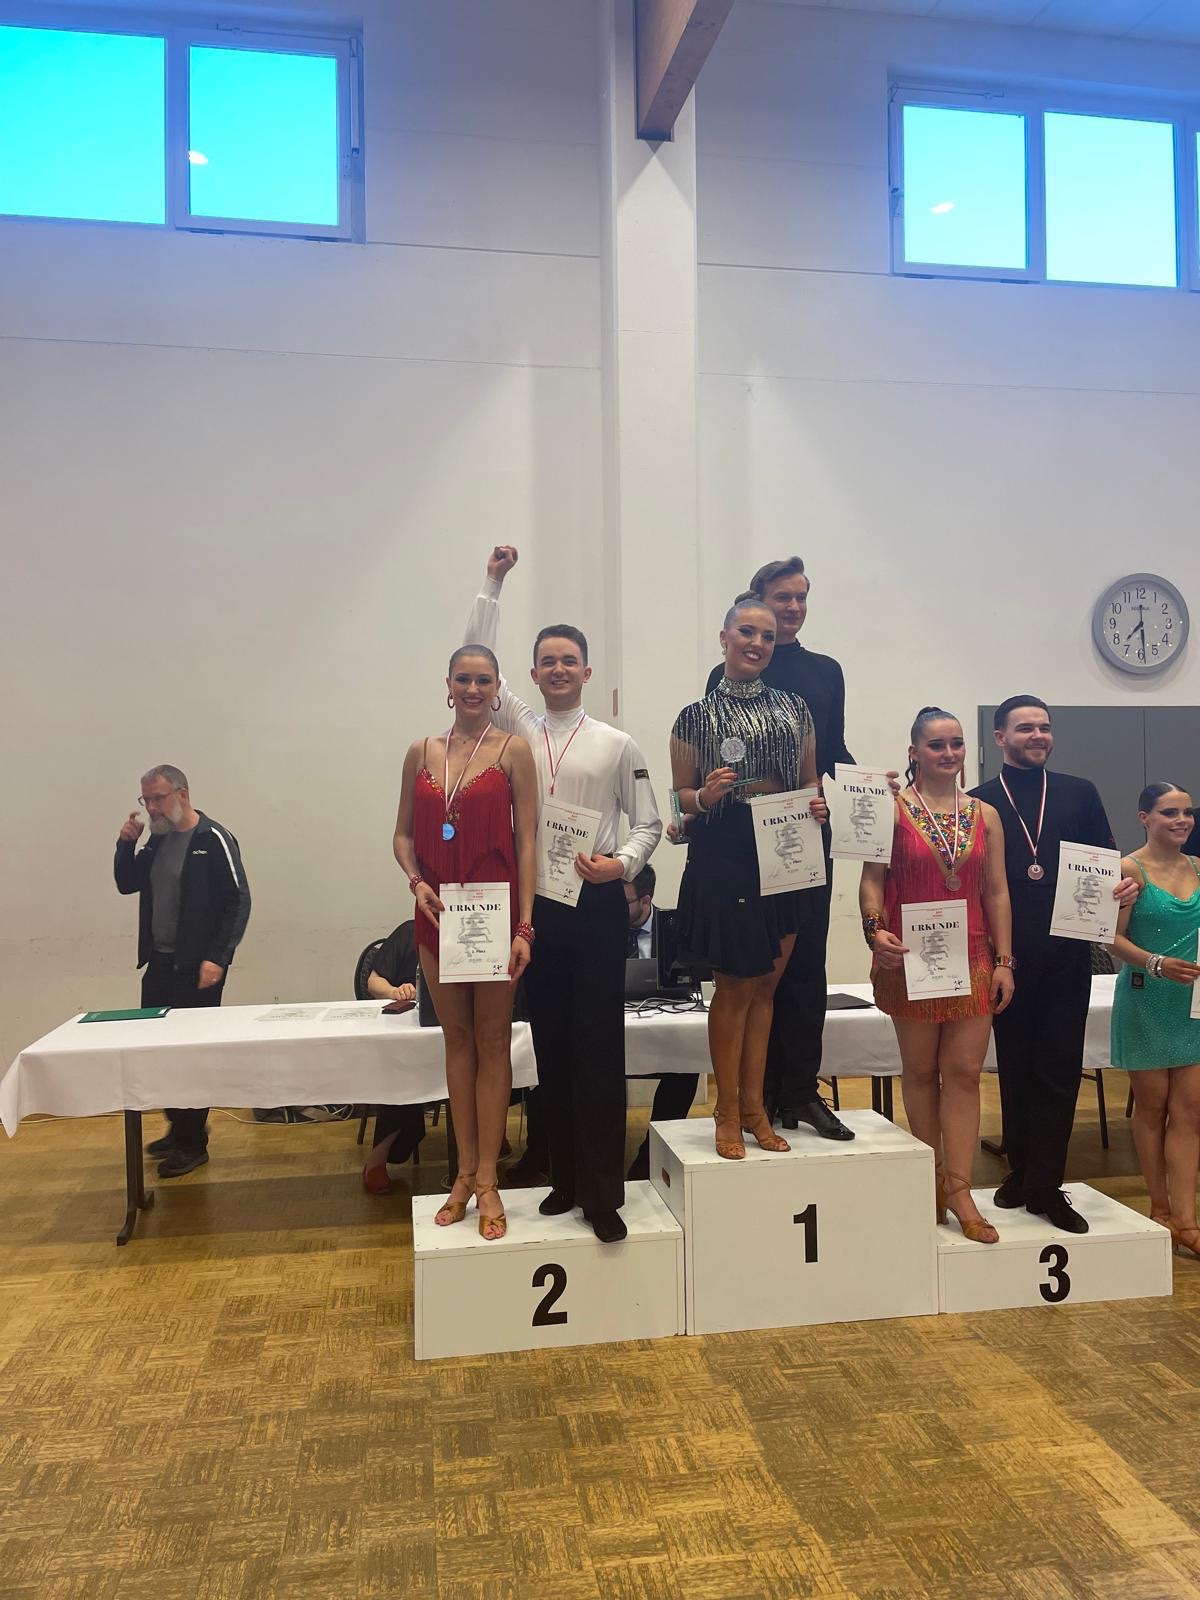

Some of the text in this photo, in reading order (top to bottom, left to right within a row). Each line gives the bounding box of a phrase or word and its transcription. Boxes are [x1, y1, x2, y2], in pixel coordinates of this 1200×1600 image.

[1123, 592, 1131, 603] 11
[1136, 588, 1146, 600] 12
[1112, 603, 1121, 614] 10
[1162, 603, 1168, 614] 2
[1109, 618, 1116, 629] 9
[1165, 618, 1172, 629] 3
[1113, 633, 1120, 645] 8
[1162, 633, 1168, 645] 4
[1124, 645, 1130, 656] 7
[1138, 648, 1145, 660] 6
[1152, 645, 1158, 655] 5
[843, 784, 888, 797] URKUNDE
[762, 811, 813, 827] URKUNDE
[546, 820, 589, 839] URKUNDE
[1068, 863, 1115, 877] URKUNDE
[449, 903, 501, 912] URKUNDE
[911, 921, 960, 932] URKUNDE
[792, 1203, 818, 1264] 1
[1038, 1243, 1072, 1304] 3
[531, 1262, 569, 1328] 2
